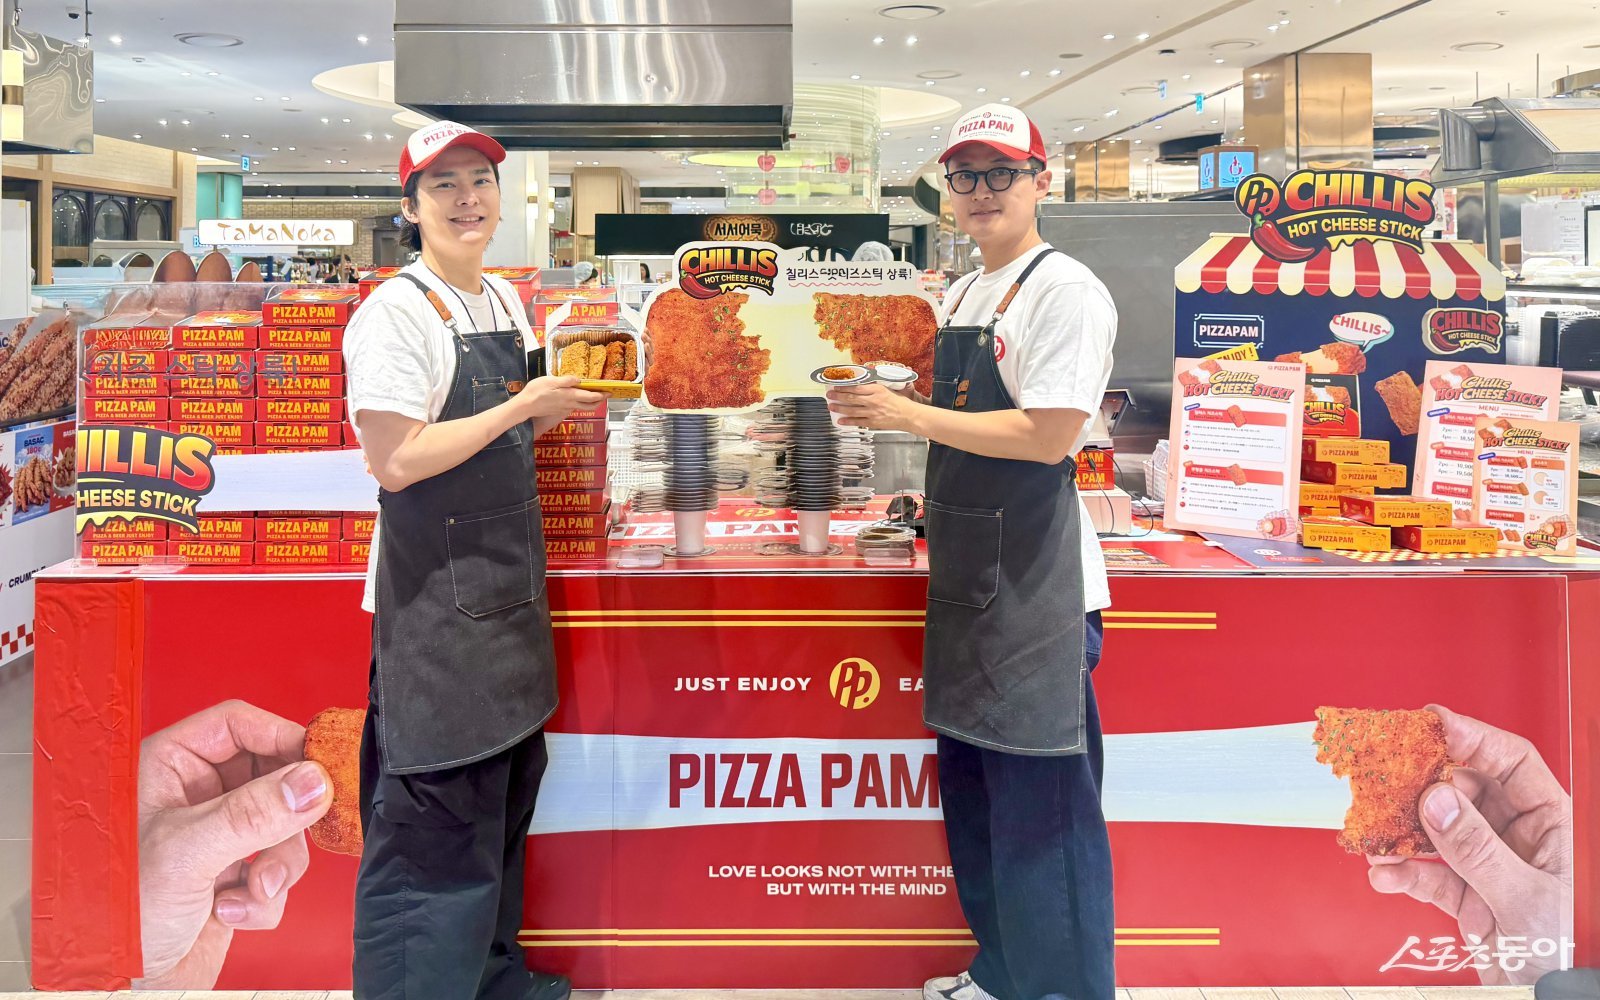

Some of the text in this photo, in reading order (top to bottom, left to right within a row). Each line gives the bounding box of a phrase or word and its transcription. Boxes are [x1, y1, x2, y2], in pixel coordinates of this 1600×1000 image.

[959, 120, 985, 136] PIZZA
[988, 120, 1014, 132] PAM
[424, 130, 455, 146] PIZZA
[1284, 172, 1433, 222] CHILLIS
[217, 222, 336, 241] TaMaNoka
[714, 223, 762, 236] 서서어묵
[1288, 218, 1423, 241] HOT CHEESE STICK
[681, 248, 778, 277] CHILLIS
[704, 274, 770, 286] HOT CHEESE STICK
[886, 268, 912, 280] 상륙!
[273, 307, 335, 317] PIZZA PAM
[582, 306, 606, 316] PAM
[1432, 312, 1500, 335] CHILLIS
[183, 330, 244, 340] PIZZA PAM
[270, 330, 330, 342] PIZZA PAM
[1199, 325, 1259, 338] PIZZAPAM
[1480, 334, 1496, 344] STICK
[305, 356, 329, 365] PAM
[1209, 370, 1259, 384] Chillis
[1461, 376, 1512, 389] Chillis
[305, 379, 330, 389] PAM
[1184, 383, 1294, 400] HOT CHEESE STICK!
[1434, 388, 1548, 407] HOT CHEESE STICK!
[95, 401, 156, 412] PIZZA PAM
[181, 402, 243, 413] PIZZA PAM
[267, 402, 330, 413] PIZZA PAM
[1304, 402, 1345, 416] CHILLIS
[217, 426, 241, 436] PAM
[266, 426, 328, 436] PIZZA PAM
[569, 423, 594, 434] PAM
[1502, 427, 1542, 438] Chillis
[24, 436, 44, 447] BASAC
[1483, 436, 1570, 451] HOT CHEESE STICK!
[535, 446, 594, 458] PIZZA PAM
[569, 471, 594, 481] PAM
[77, 489, 198, 516] HEESE STICK
[565, 494, 590, 505] PAM
[217, 522, 242, 532] PAM
[267, 522, 328, 533] PIZZA PAM
[354, 521, 376, 531] PIZ
[568, 518, 593, 528] PAM
[1525, 533, 1558, 546] CHILLIS
[92, 545, 154, 556] PIZZA PAM
[179, 545, 240, 556] PIZZA PAM
[266, 545, 328, 556] PIZZA PAM
[352, 545, 370, 556] PIZ
[546, 542, 595, 552] ZZA PAM
[9, 566, 46, 588] CRUM
[674, 677, 812, 692] JUST ENJOY
[900, 677, 924, 692] EA
[669, 753, 940, 808] PIZZA PAM
[708, 866, 956, 878] LOVE LOOKS NOT WITH THE
[766, 883, 947, 896] BUT WITH THE MIND
